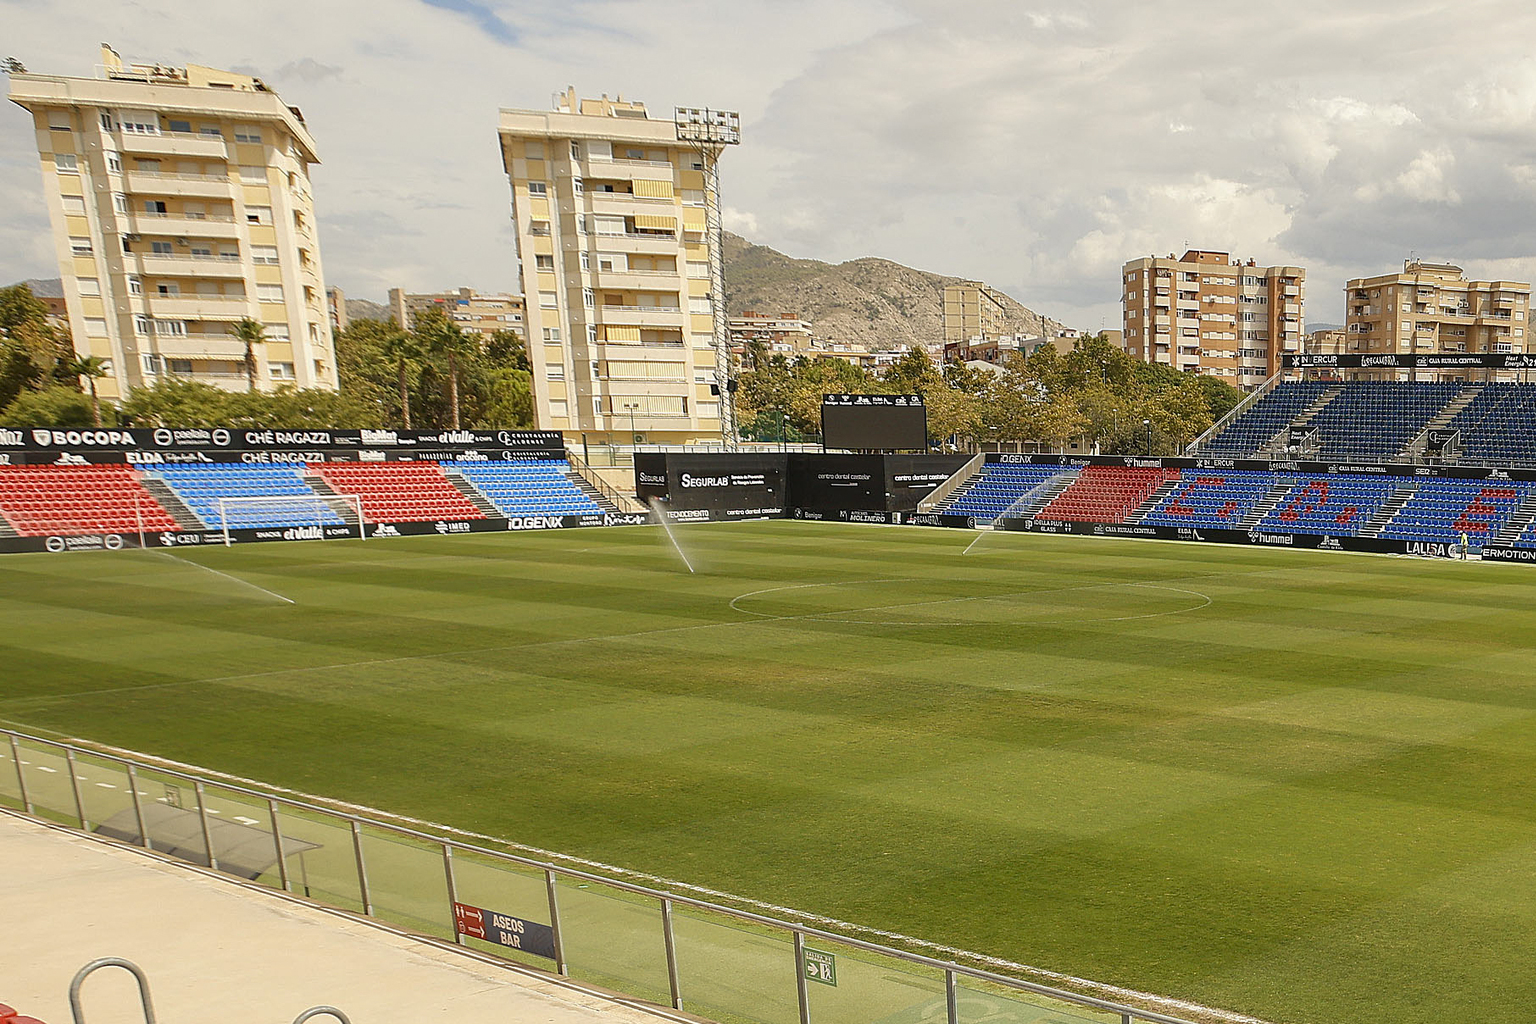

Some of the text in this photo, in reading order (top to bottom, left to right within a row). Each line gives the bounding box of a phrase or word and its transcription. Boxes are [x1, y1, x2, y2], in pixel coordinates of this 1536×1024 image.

[52, 431, 136, 445] BOCOPA
[245, 430, 274, 444] CHÉ
[275, 432, 330, 444] RAGAZZI
[125, 452, 165, 464] ELDA
[242, 451, 270, 463] CHÉ
[271, 453, 326, 463] RAGAZZI
[1134, 459, 1161, 468] hummel
[681, 473, 729, 487] SEGURLAB
[1259, 532, 1293, 544] hummel
[492, 914, 524, 934] ASEOS
[500, 931, 521, 949] BAR
